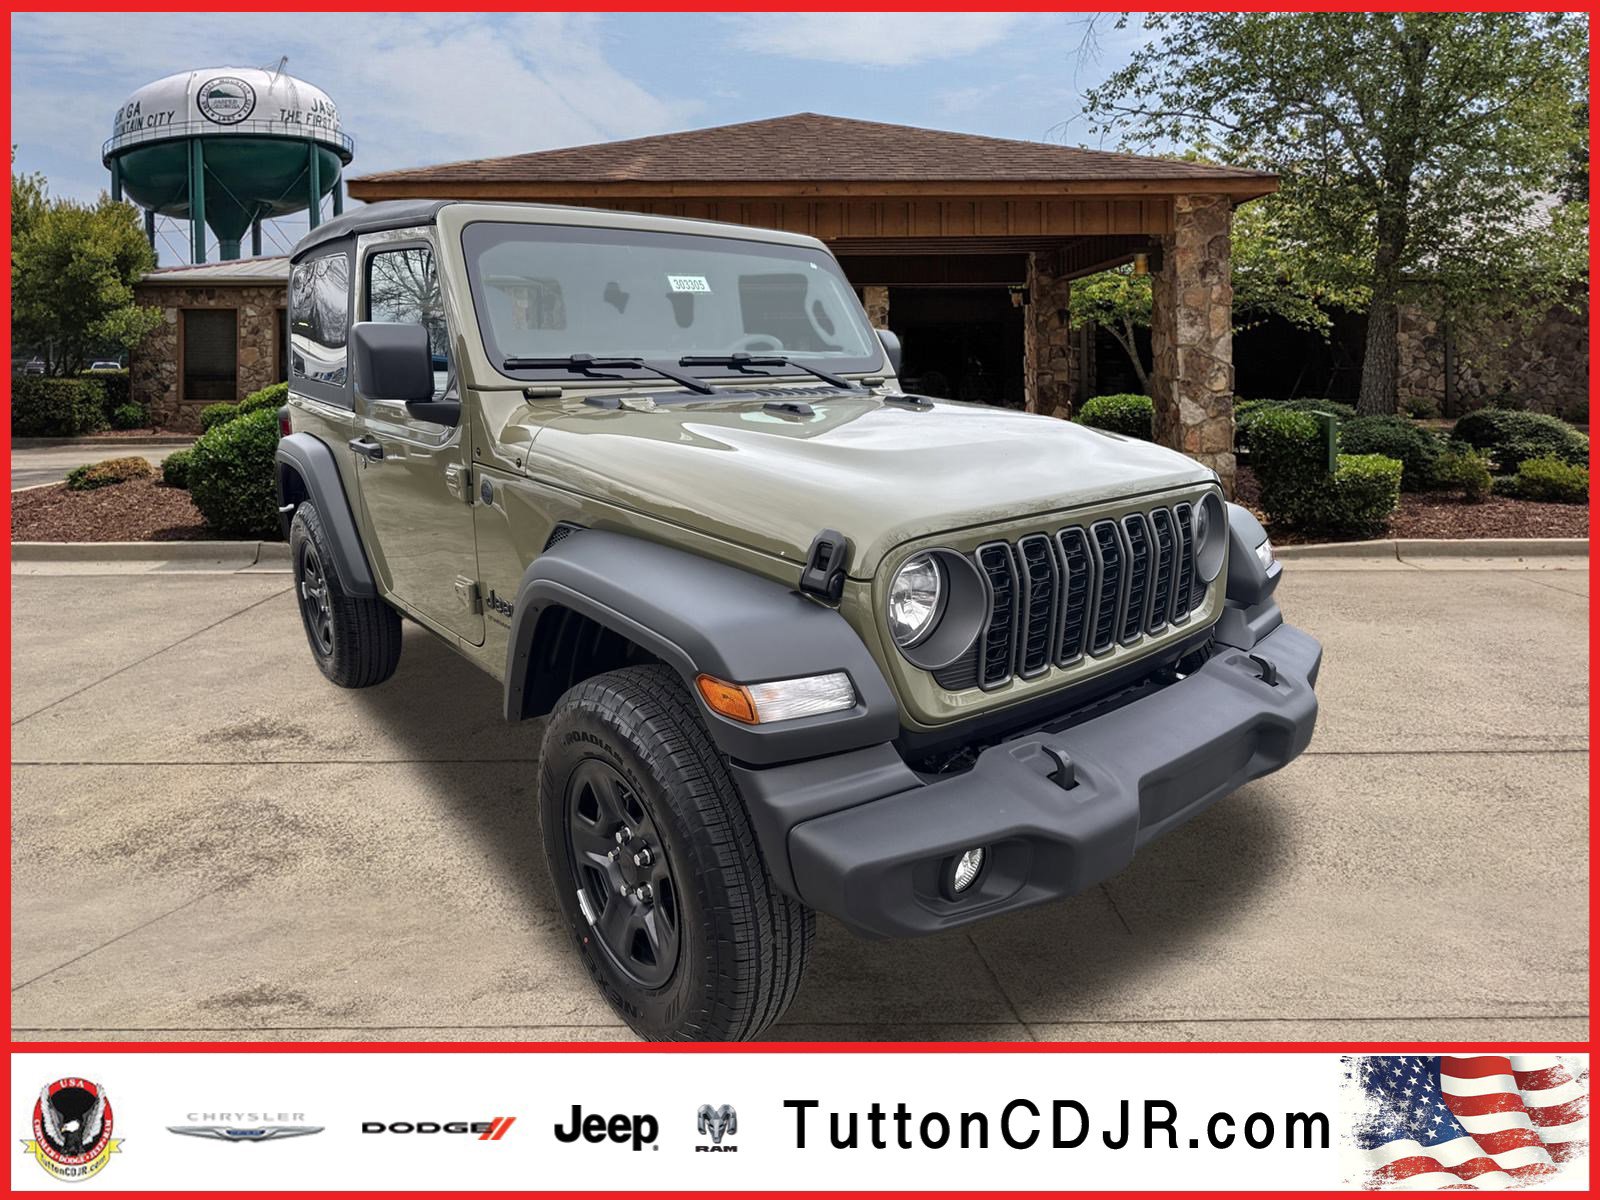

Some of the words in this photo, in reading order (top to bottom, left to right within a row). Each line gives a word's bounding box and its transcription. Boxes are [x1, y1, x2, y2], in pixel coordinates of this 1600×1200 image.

[126, 100, 141, 119] GA
[280, 108, 302, 124] THE
[147, 110, 175, 127] CITY
[673, 279, 706, 290] 303305
